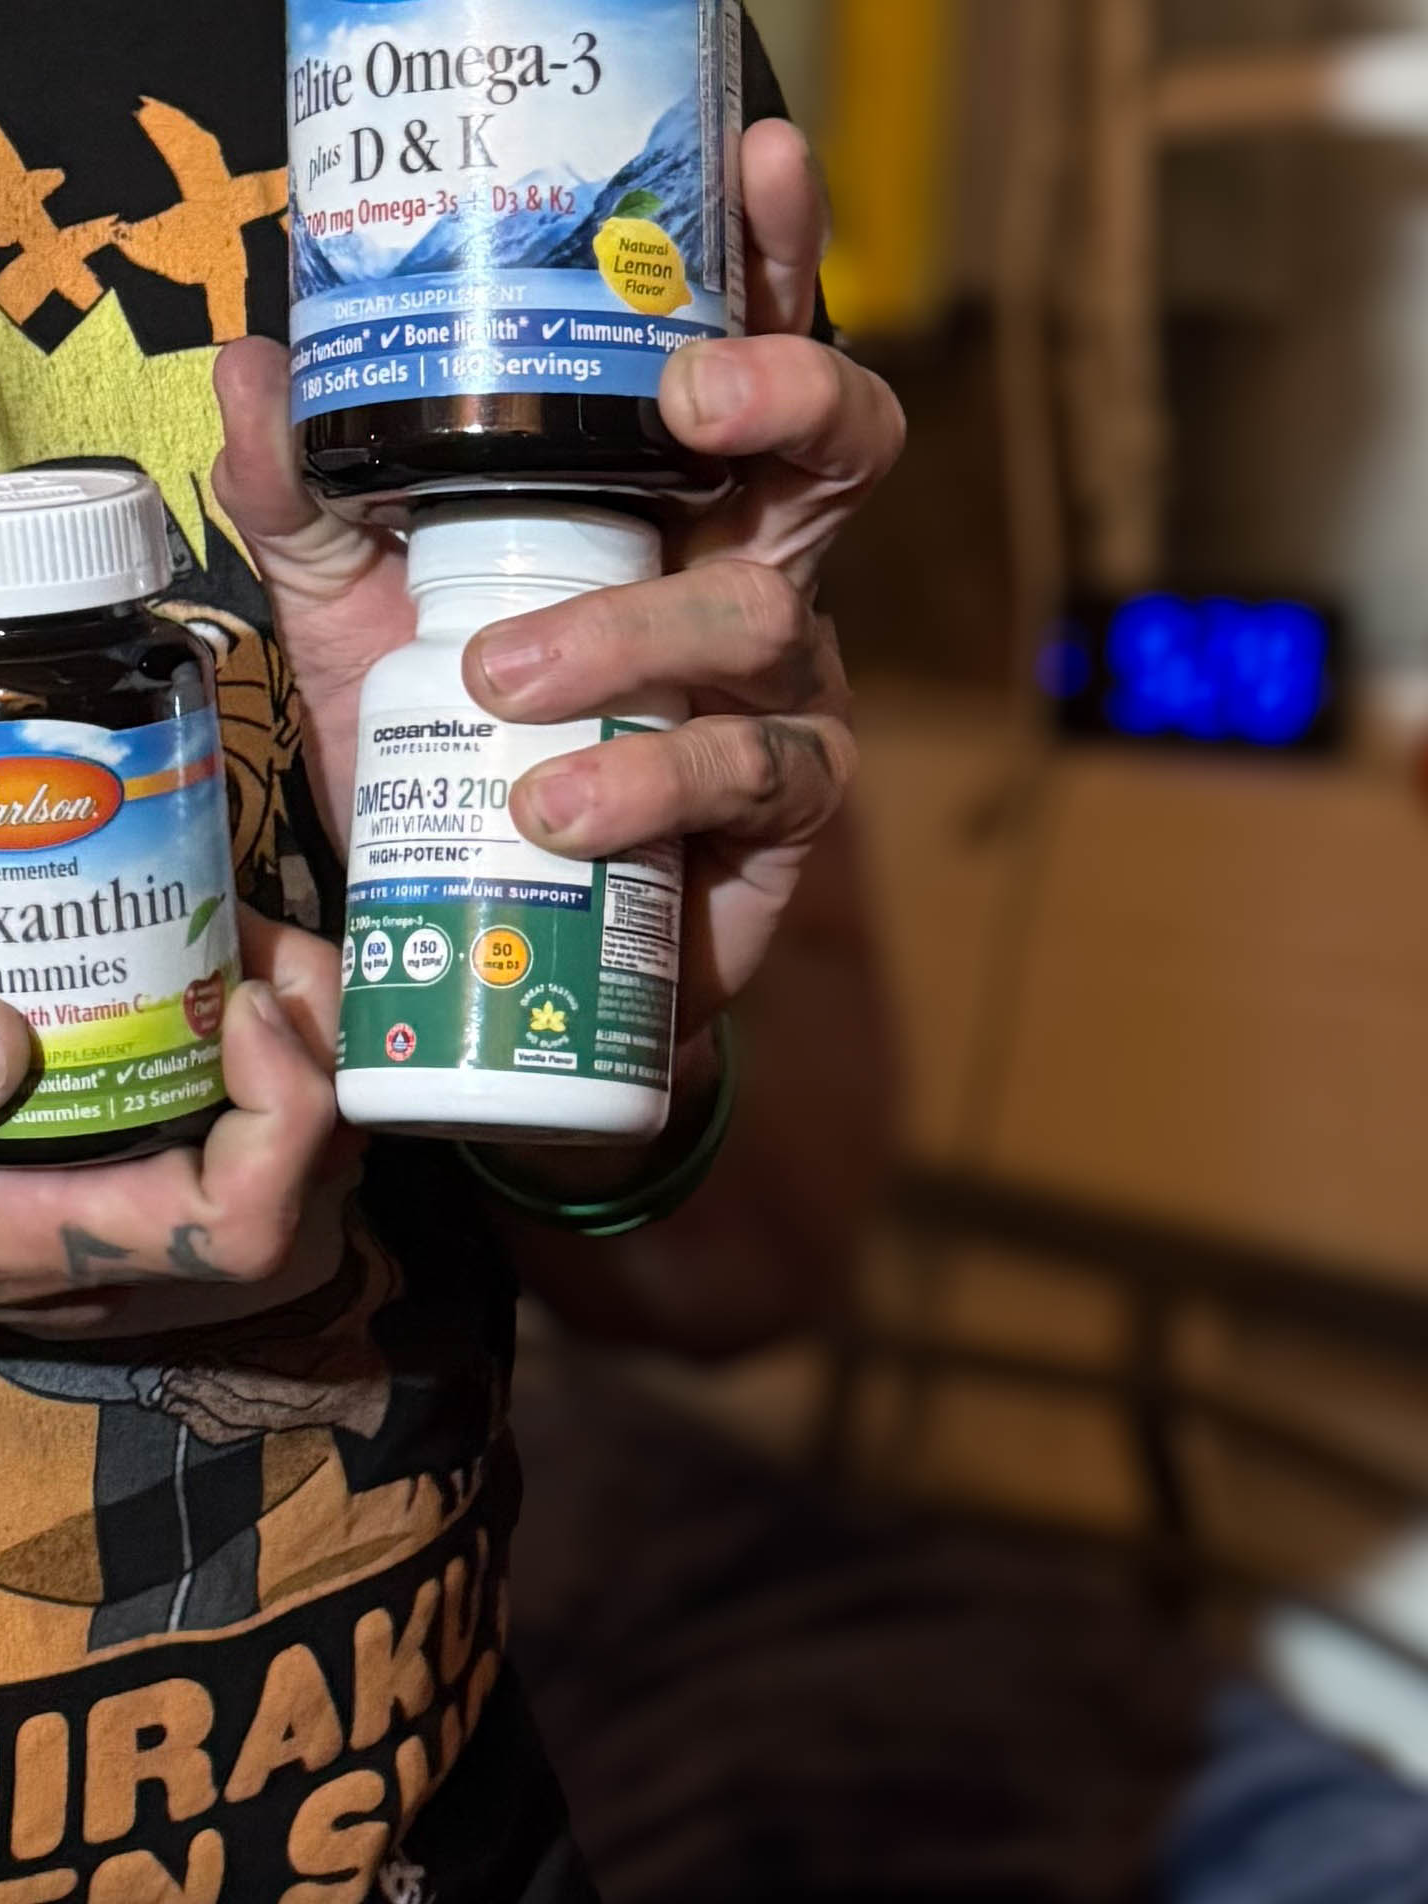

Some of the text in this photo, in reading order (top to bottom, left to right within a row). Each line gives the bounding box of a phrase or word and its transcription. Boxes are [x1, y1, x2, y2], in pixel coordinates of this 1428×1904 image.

[293, 31, 602, 126] Elite Omega-3
[308, 113, 498, 191] plus D & K
[330, 208, 354, 235] mg
[358, 190, 459, 227] Omega-3s
[492, 184, 519, 216] D3
[526, 184, 544, 211] &
[549, 184, 576, 214] K2
[618, 237, 669, 256] Natural
[614, 256, 673, 280] Lemon
[625, 279, 666, 297] Flavor
[334, 294, 397, 322] DIETARY
[403, 323, 449, 347] Bone
[569, 318, 644, 345] Immune
[302, 375, 323, 403] 180
[324, 365, 360, 395] Soft
[361, 359, 409, 387] Gels
[491, 351, 603, 382] Servings
[373, 719, 494, 744] oceanblue
[379, 741, 481, 757] PROFESSIONAL
[457, 777, 509, 810] 210
[370, 813, 484, 838] WITH VITAMIN D
[368, 845, 484, 866] HIGH-POTENCY
[394, 883, 430, 898] JOINT
[442, 885, 504, 900] IMMUNE
[412, 940, 438, 955] 150
[492, 942, 513, 957] 50
[26, 993, 147, 1027] ith Vitamin C
[47, 1041, 135, 1064] PPLEMENT
[137, 1057, 188, 1081] Cellular
[123, 1096, 146, 1113] 23
[149, 1076, 215, 1107] Servings
